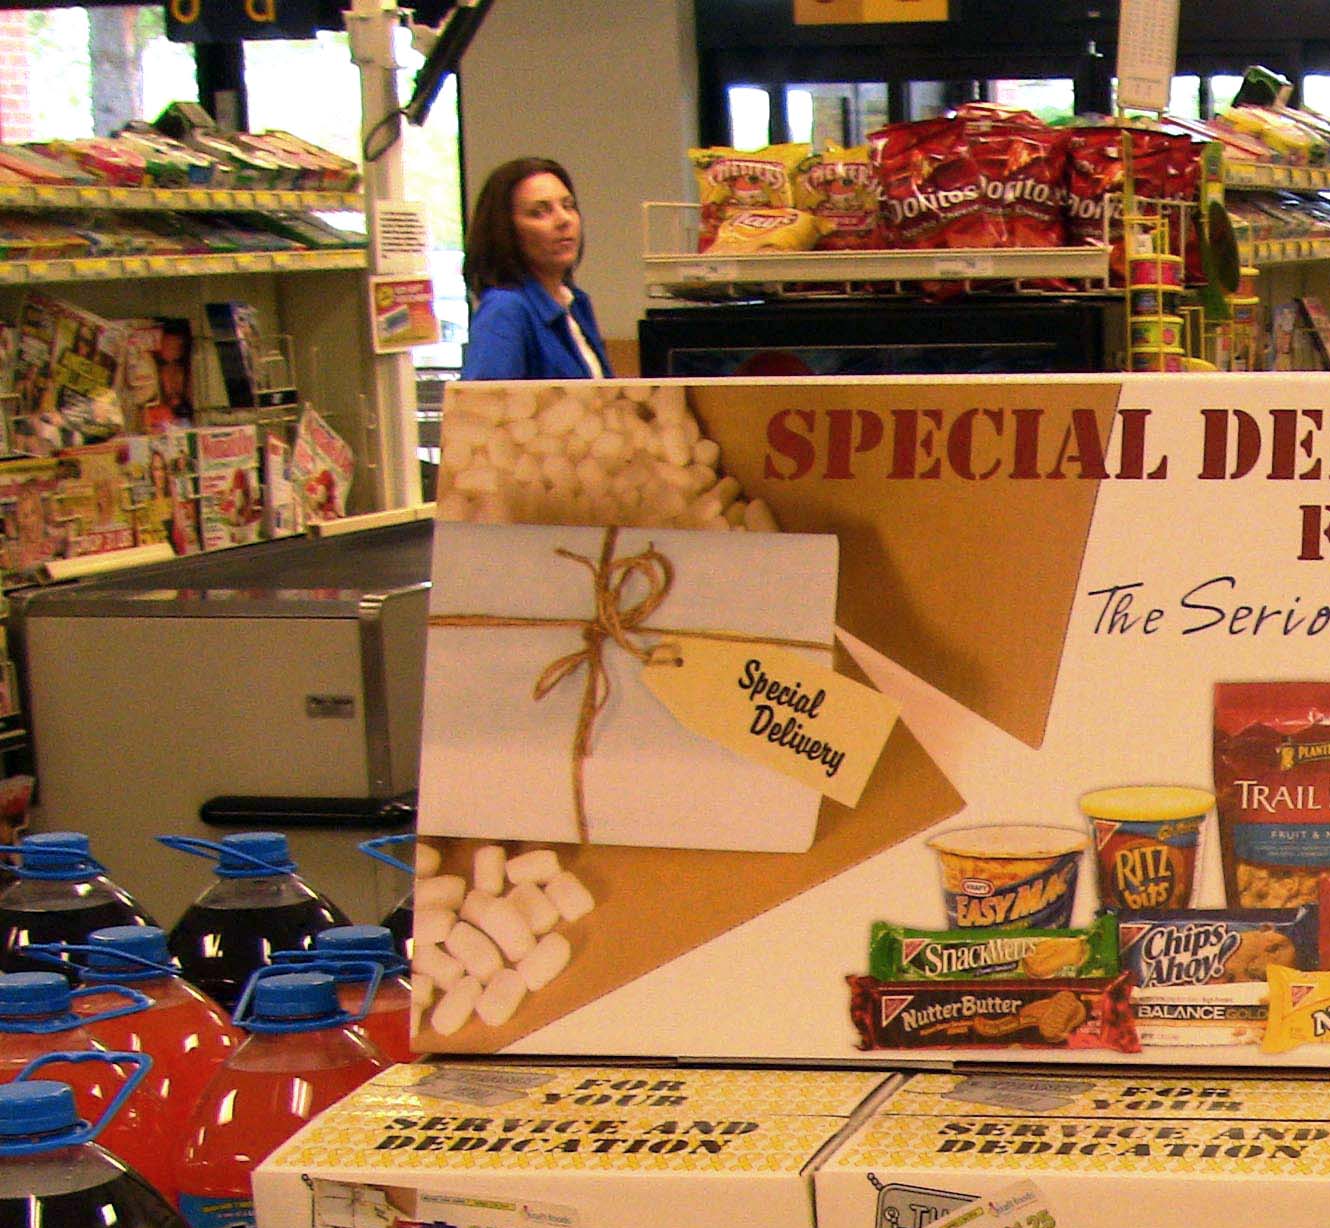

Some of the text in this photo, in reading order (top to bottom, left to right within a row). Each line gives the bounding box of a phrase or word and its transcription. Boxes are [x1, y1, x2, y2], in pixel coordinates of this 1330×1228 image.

[764, 408, 1169, 481] SPECIAL
[1089, 583, 1165, 636] The
[738, 658, 825, 719] Special
[749, 705, 846, 777] Delivery
[1233, 781, 1322, 813] TRAIL
[1271, 831, 1306, 839] FRUIT
[1117, 845, 1172, 887] RITZ
[957, 895, 1015, 927] EASY
[1123, 878, 1169, 909] bits
[1147, 924, 1225, 958] Chips
[1148, 931, 1241, 986] Ahoy!
[1138, 1006, 1224, 1019] BALANCE
